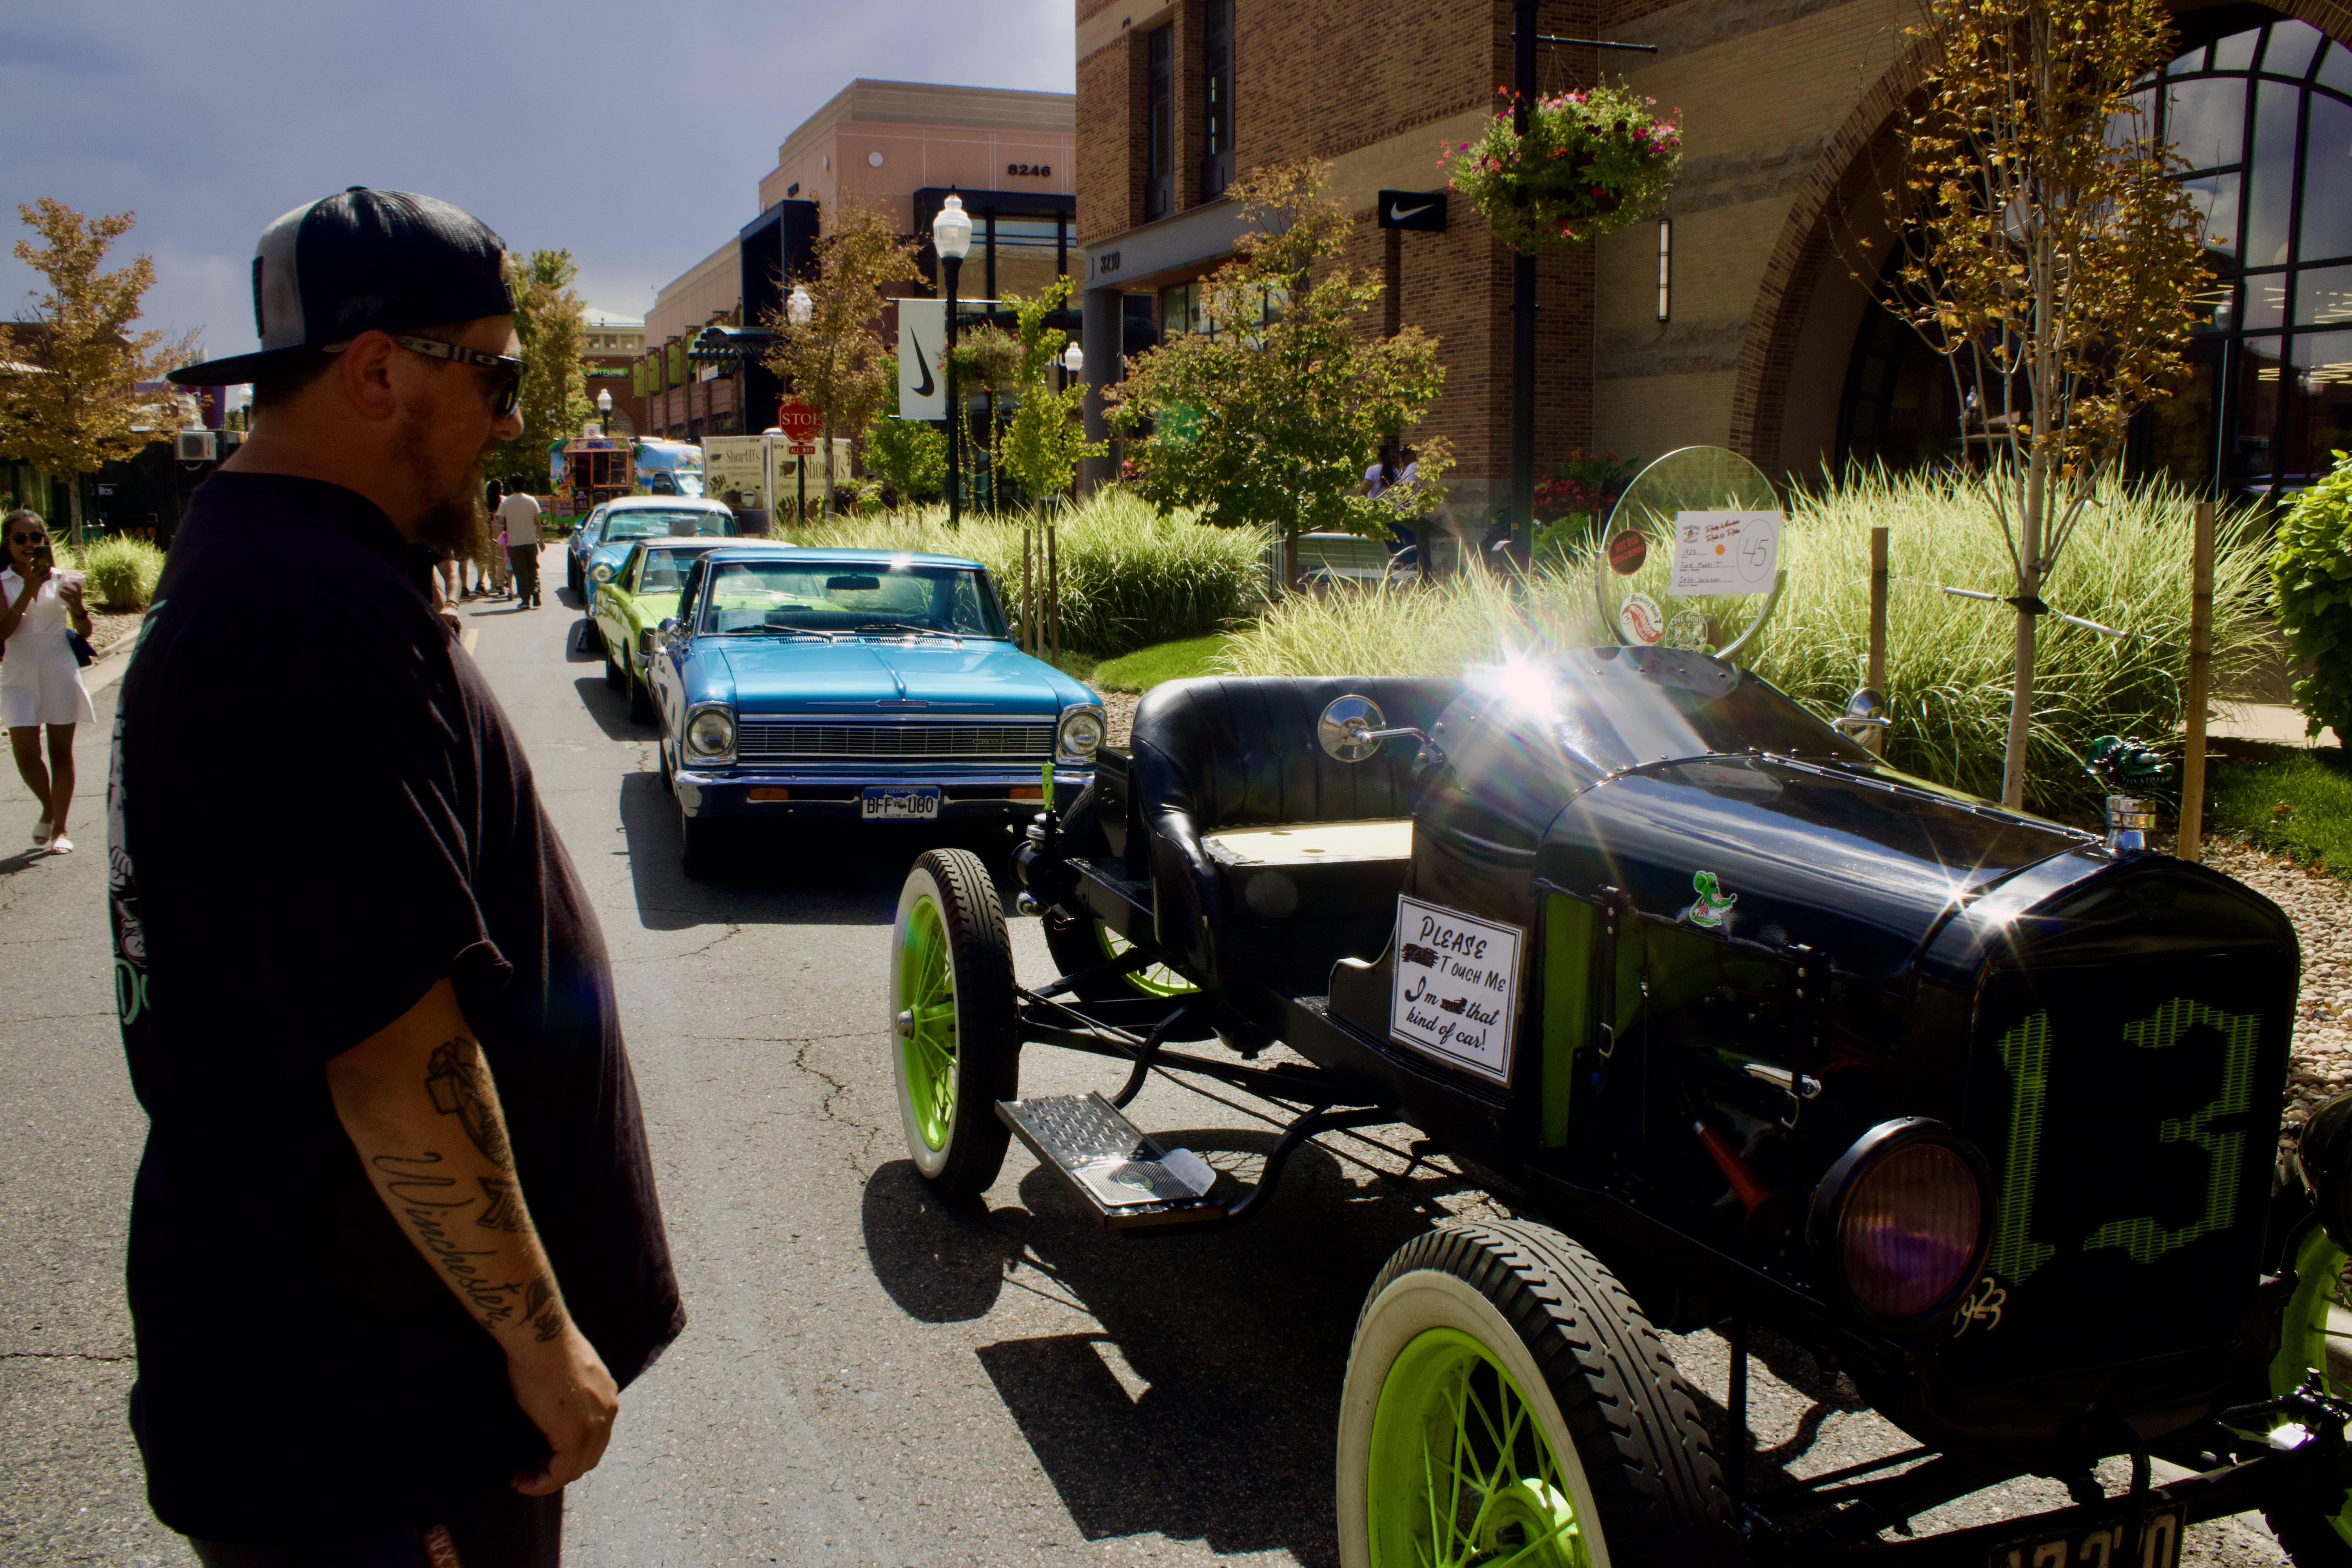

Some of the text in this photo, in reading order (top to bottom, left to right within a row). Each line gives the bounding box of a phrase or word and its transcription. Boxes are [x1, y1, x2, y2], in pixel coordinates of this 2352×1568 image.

[1008, 164, 1051, 177] 8246
[1743, 539, 1768, 566] 45
[1631, 595, 1651, 607] Berkeley
[1629, 605, 1656, 637] Northsiders
[867, 797, 893, 813] BFF
[1419, 916, 1487, 959] PLEASE
[1484, 970, 1506, 992] ME
[1466, 1002, 1500, 1026] that
[1406, 1006, 1486, 1051] kind of car!
[1988, 996, 2263, 1287] 13
[372, 1152, 524, 1321] Winchester
